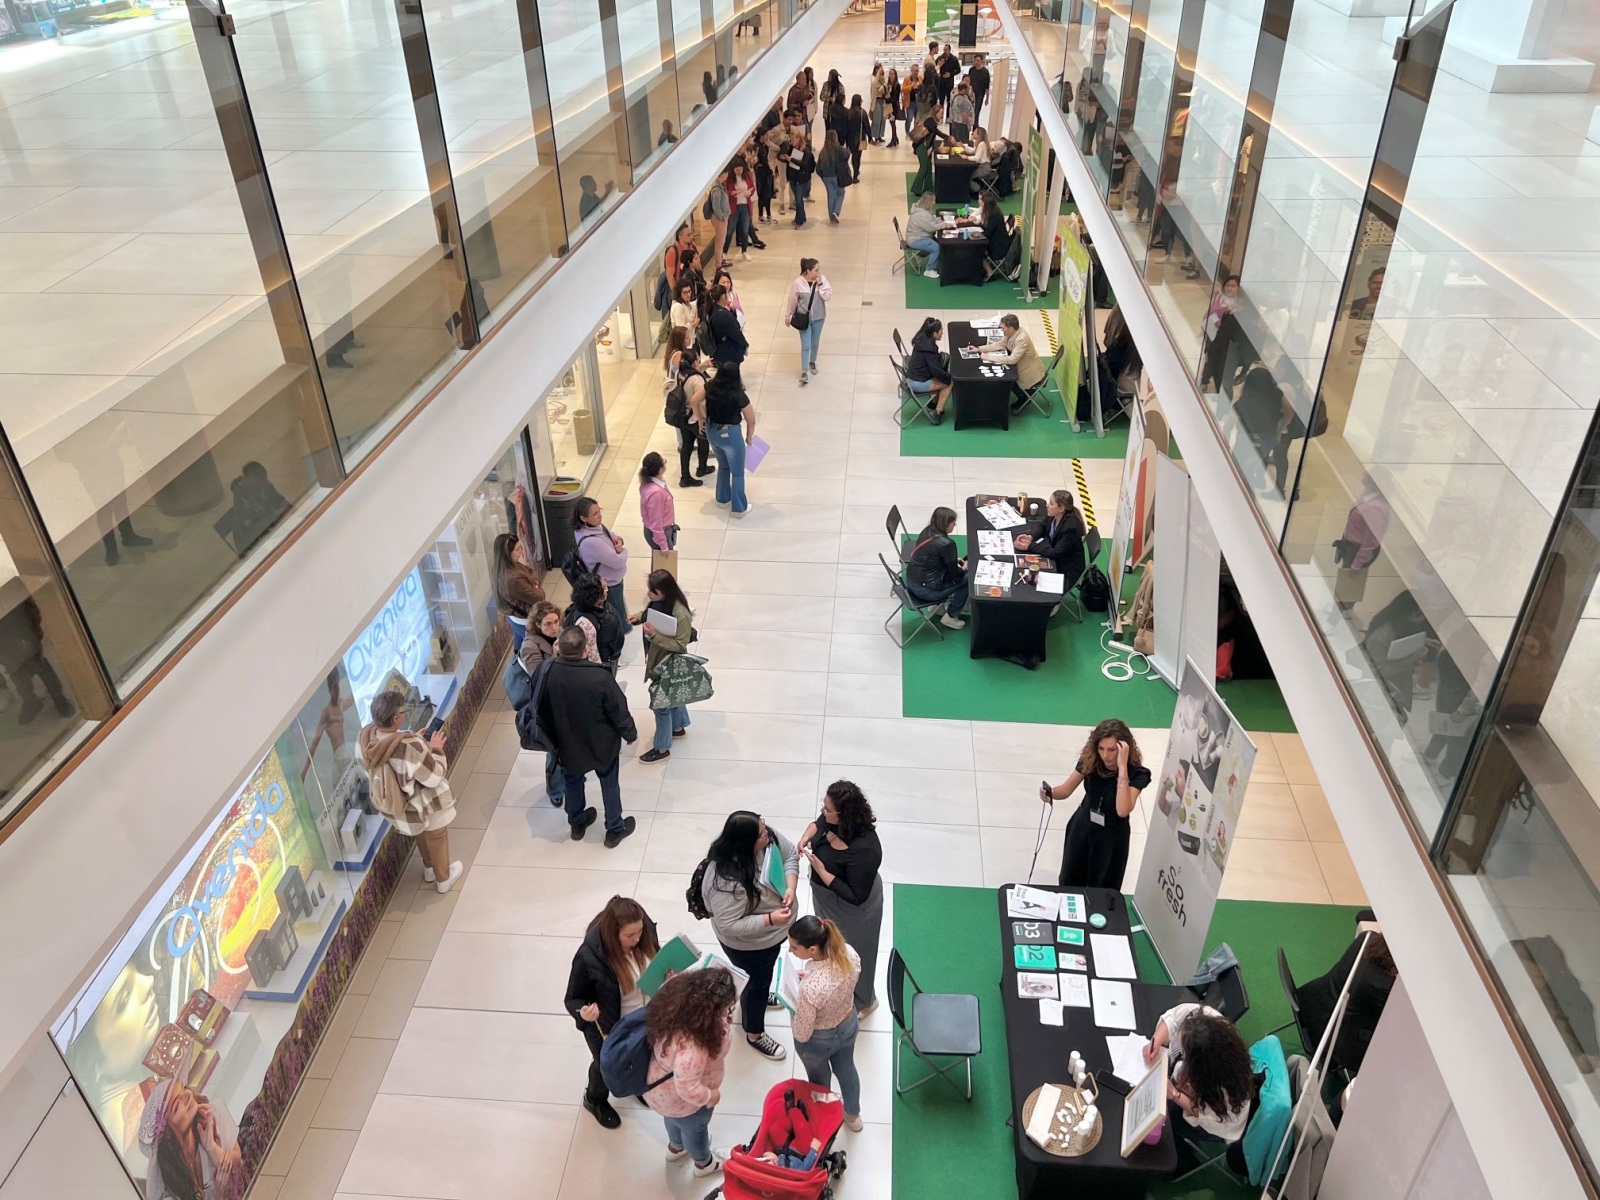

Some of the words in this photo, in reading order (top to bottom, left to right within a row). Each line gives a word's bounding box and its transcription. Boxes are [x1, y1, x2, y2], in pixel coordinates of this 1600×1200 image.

[167, 782, 285, 958] Ovenido
[1168, 865, 1184, 901] So
[1158, 869, 1187, 928] fresh
[1023, 922, 1041, 939] 03
[1028, 945, 1045, 961] 02
